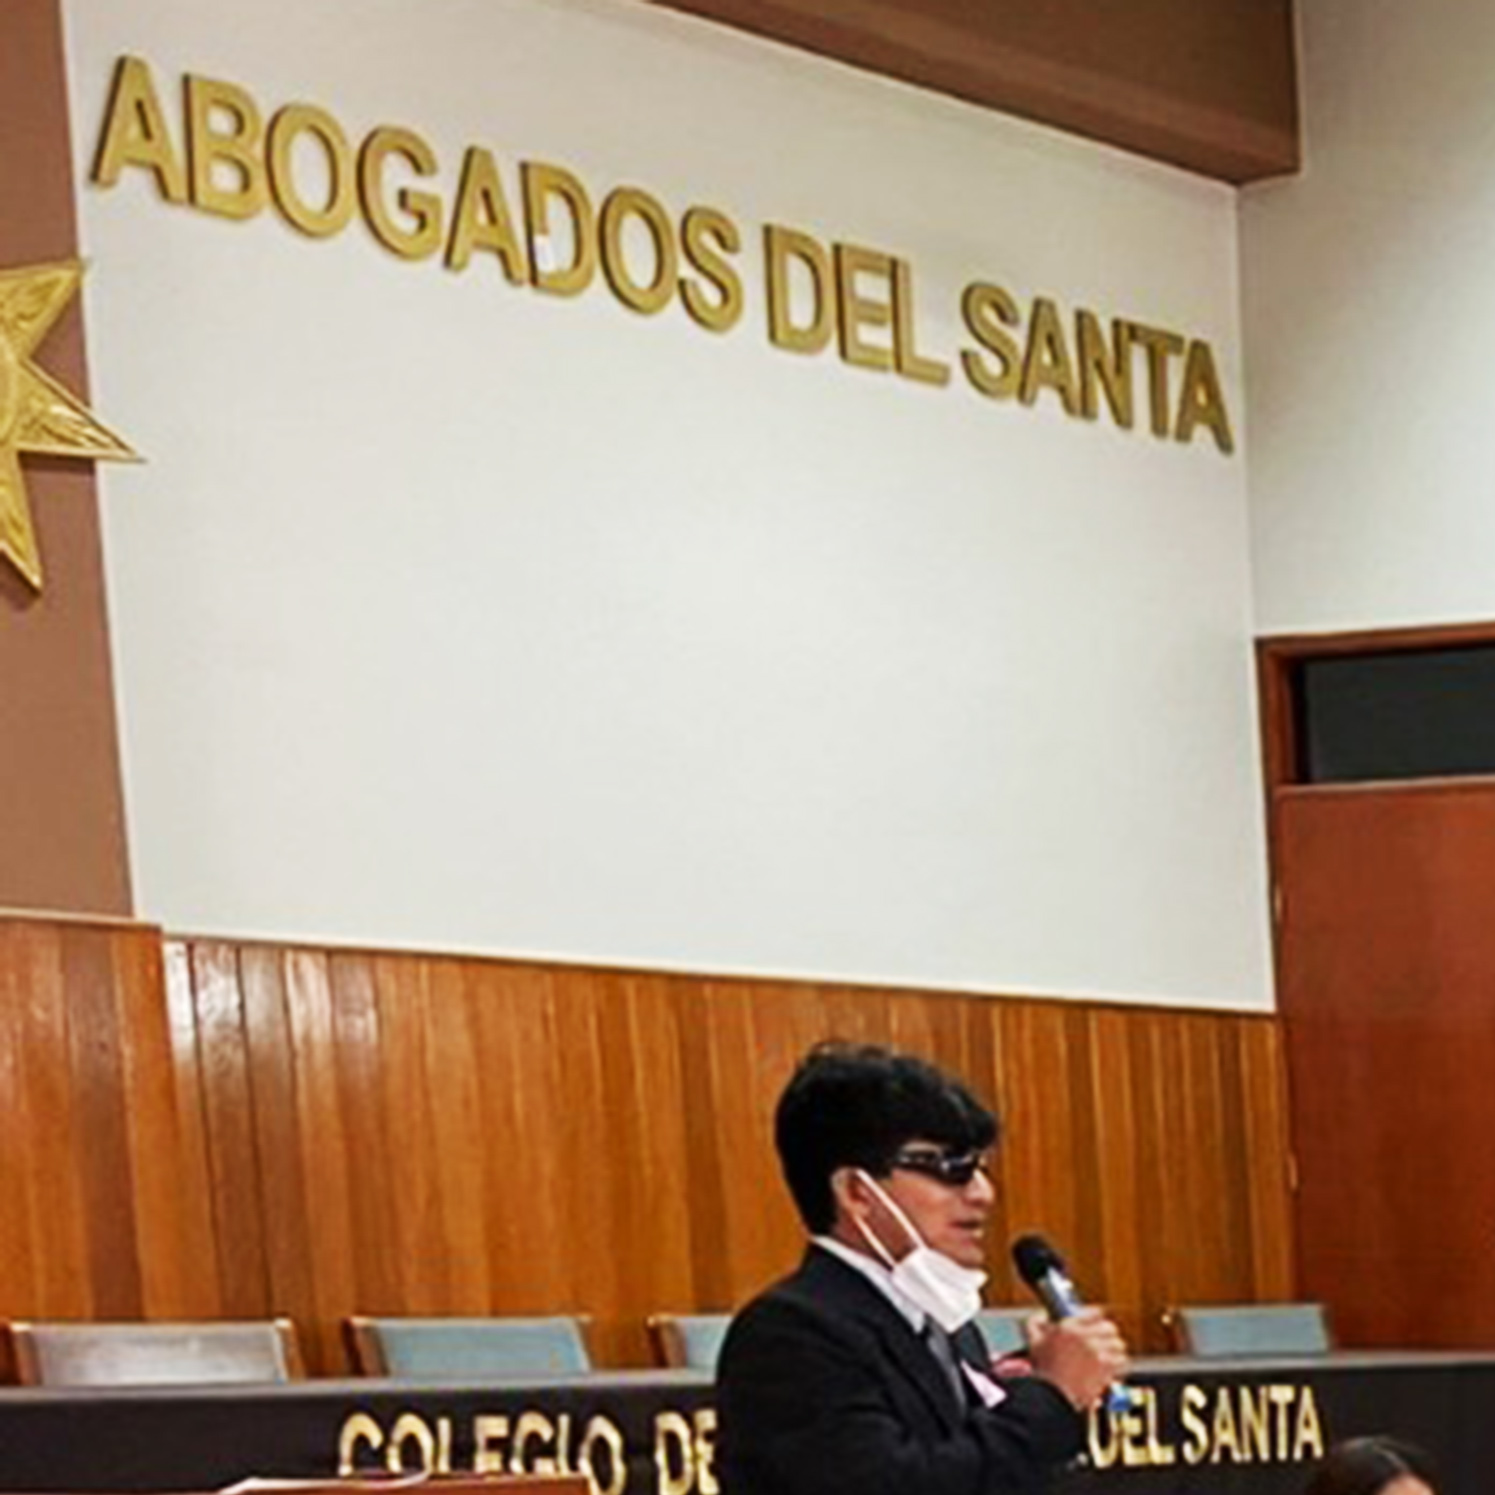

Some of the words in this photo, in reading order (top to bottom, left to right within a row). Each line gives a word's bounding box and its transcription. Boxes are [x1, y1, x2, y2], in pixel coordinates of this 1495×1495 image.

[91, 54, 745, 334] ABOGADOS
[762, 222, 952, 386] DEL
[959, 281, 1235, 456] SANTA
[1088, 1385, 1175, 1468] DEL
[1180, 1384, 1324, 1464] SANTA
